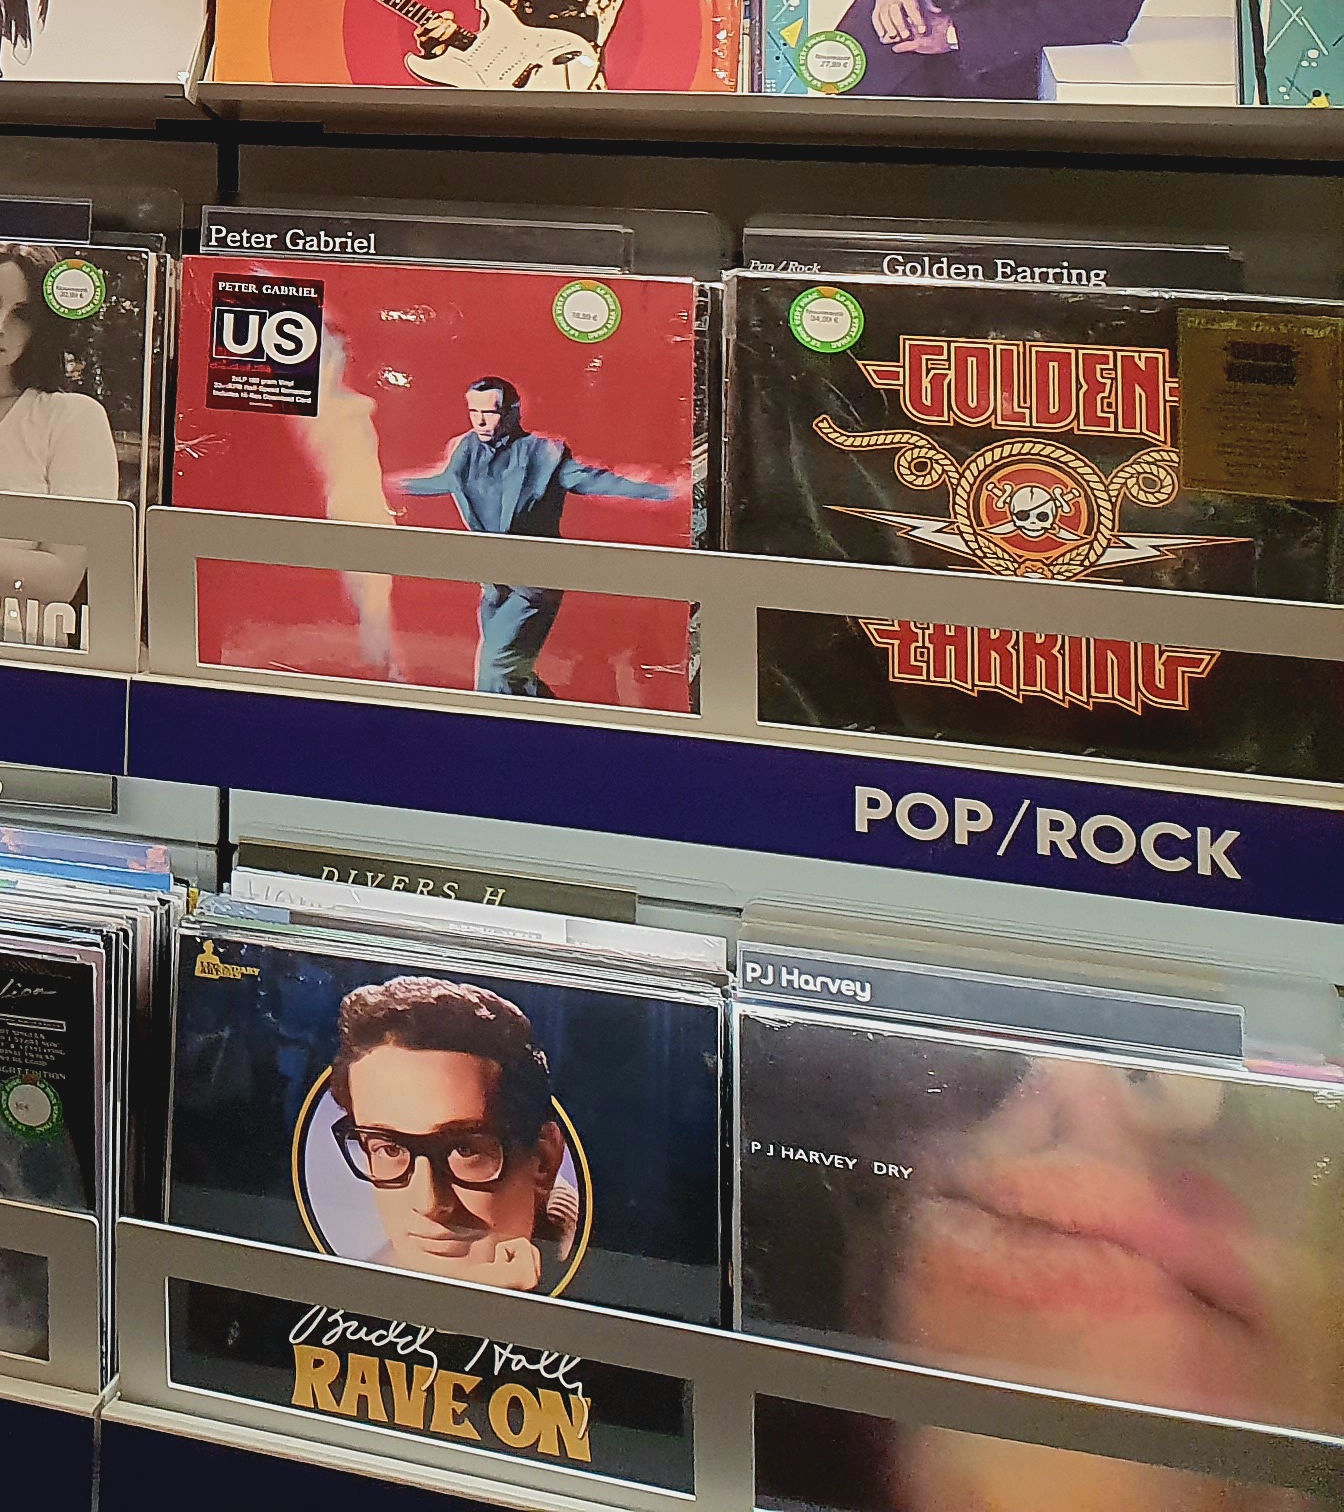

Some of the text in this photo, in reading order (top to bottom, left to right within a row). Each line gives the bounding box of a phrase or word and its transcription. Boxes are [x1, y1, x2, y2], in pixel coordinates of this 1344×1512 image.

[208, 226, 377, 254] Peter Gabriel
[749, 260, 821, 273] Pop Rock
[883, 255, 1107, 288] Golden Earring
[218, 282, 318, 297] PETER GABRIEL
[221, 311, 311, 360] US
[898, 336, 1176, 445] GOLDEN
[854, 785, 1242, 880] POP/ROCK
[321, 866, 461, 901] DIVERS
[483, 886, 506, 906] H
[745, 962, 872, 1002] PJ Harvey
[751, 1141, 914, 1181] P J HARVEY DRY
[291, 1344, 593, 1463] RAVE ON
